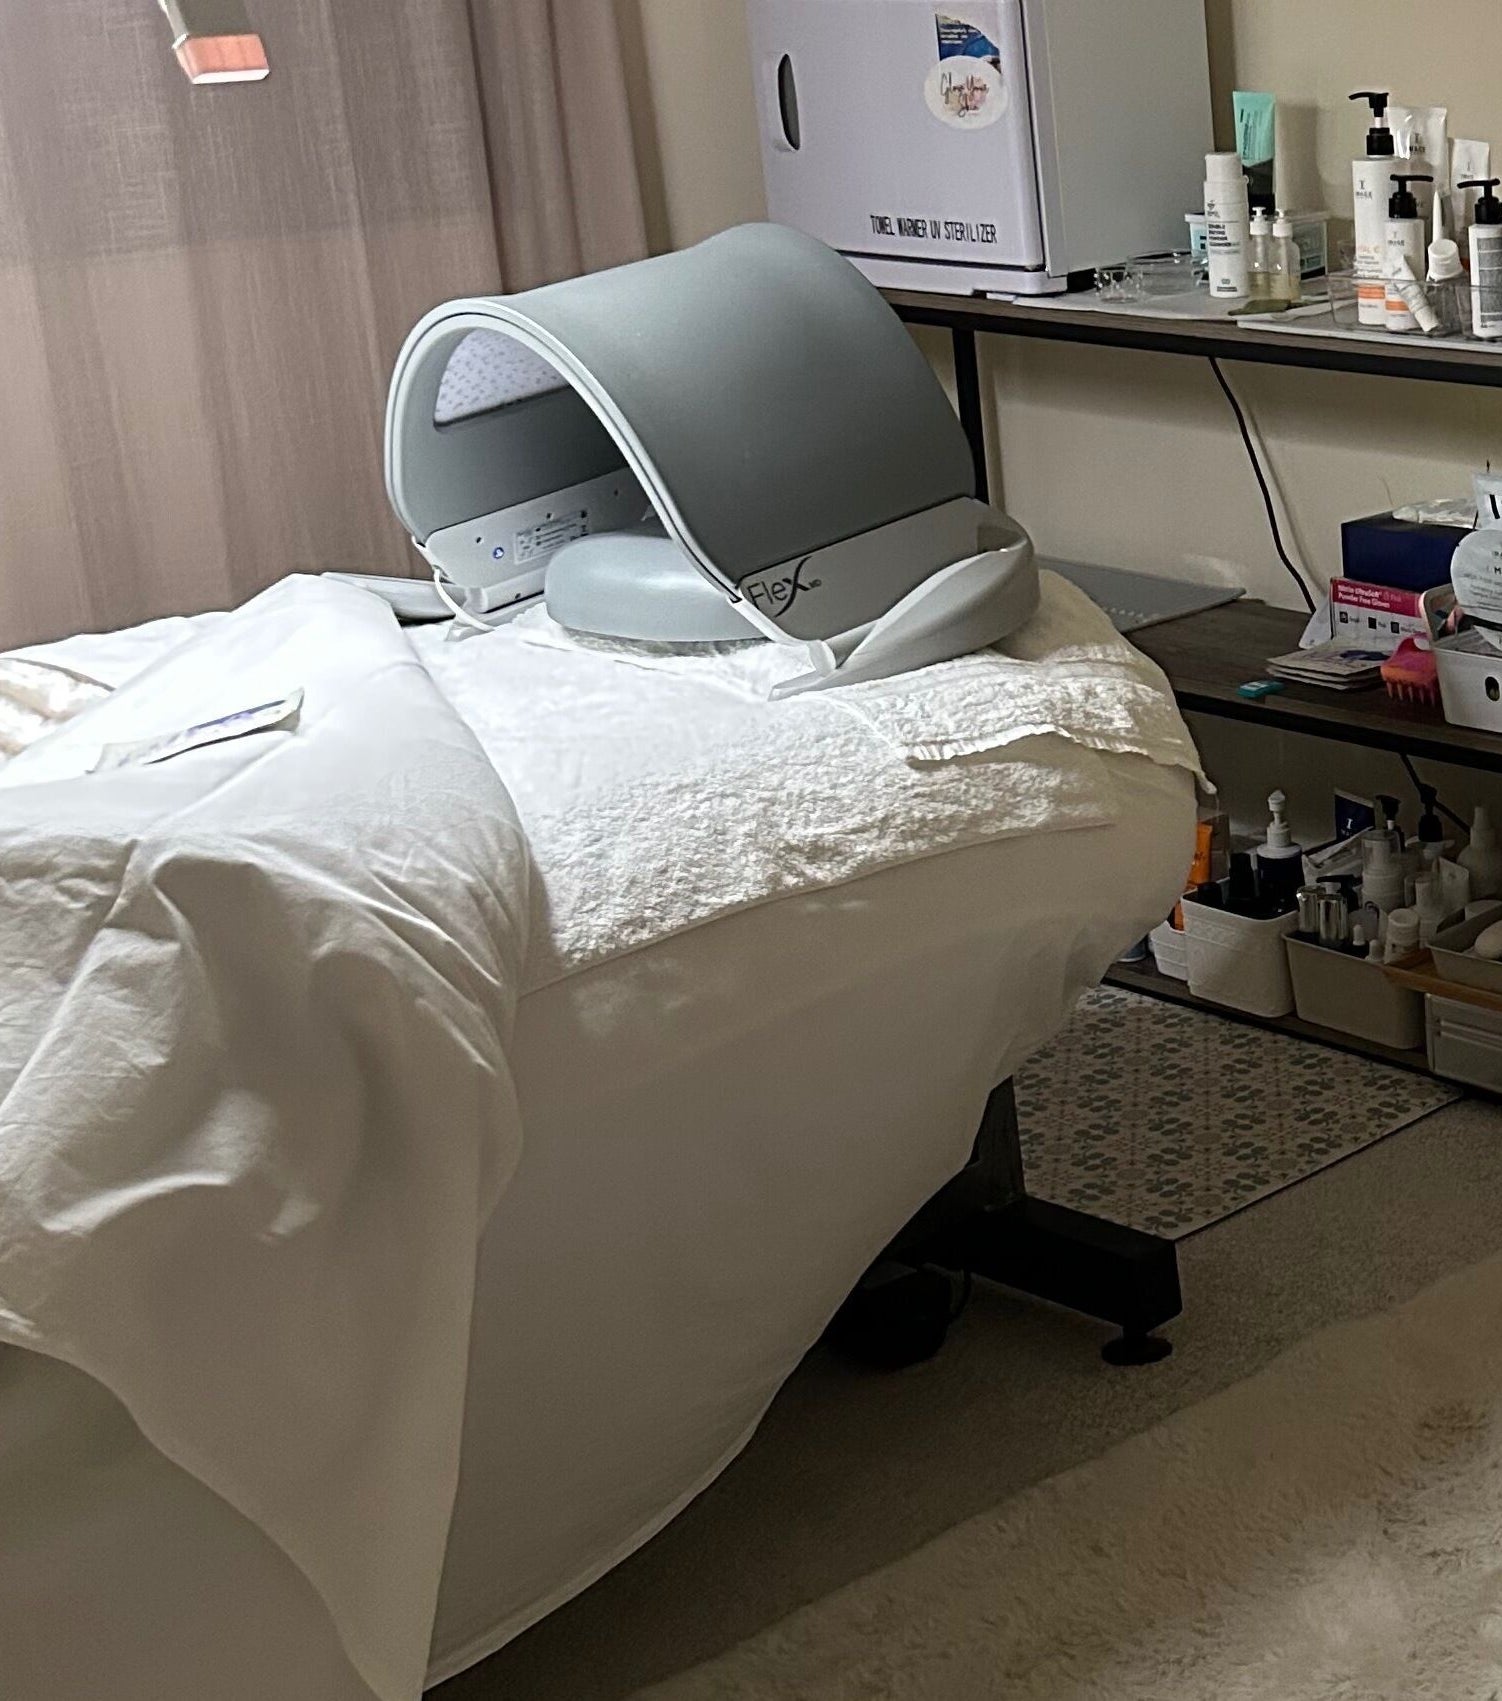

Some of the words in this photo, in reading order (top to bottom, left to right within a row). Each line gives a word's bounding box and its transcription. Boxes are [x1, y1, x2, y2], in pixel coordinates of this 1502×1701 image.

[870, 214, 896, 236] TOWEL
[897, 217, 928, 238] WARMER
[930, 220, 941, 240] UV
[944, 221, 998, 243] STERILIZER
[747, 556, 813, 618] Flex
